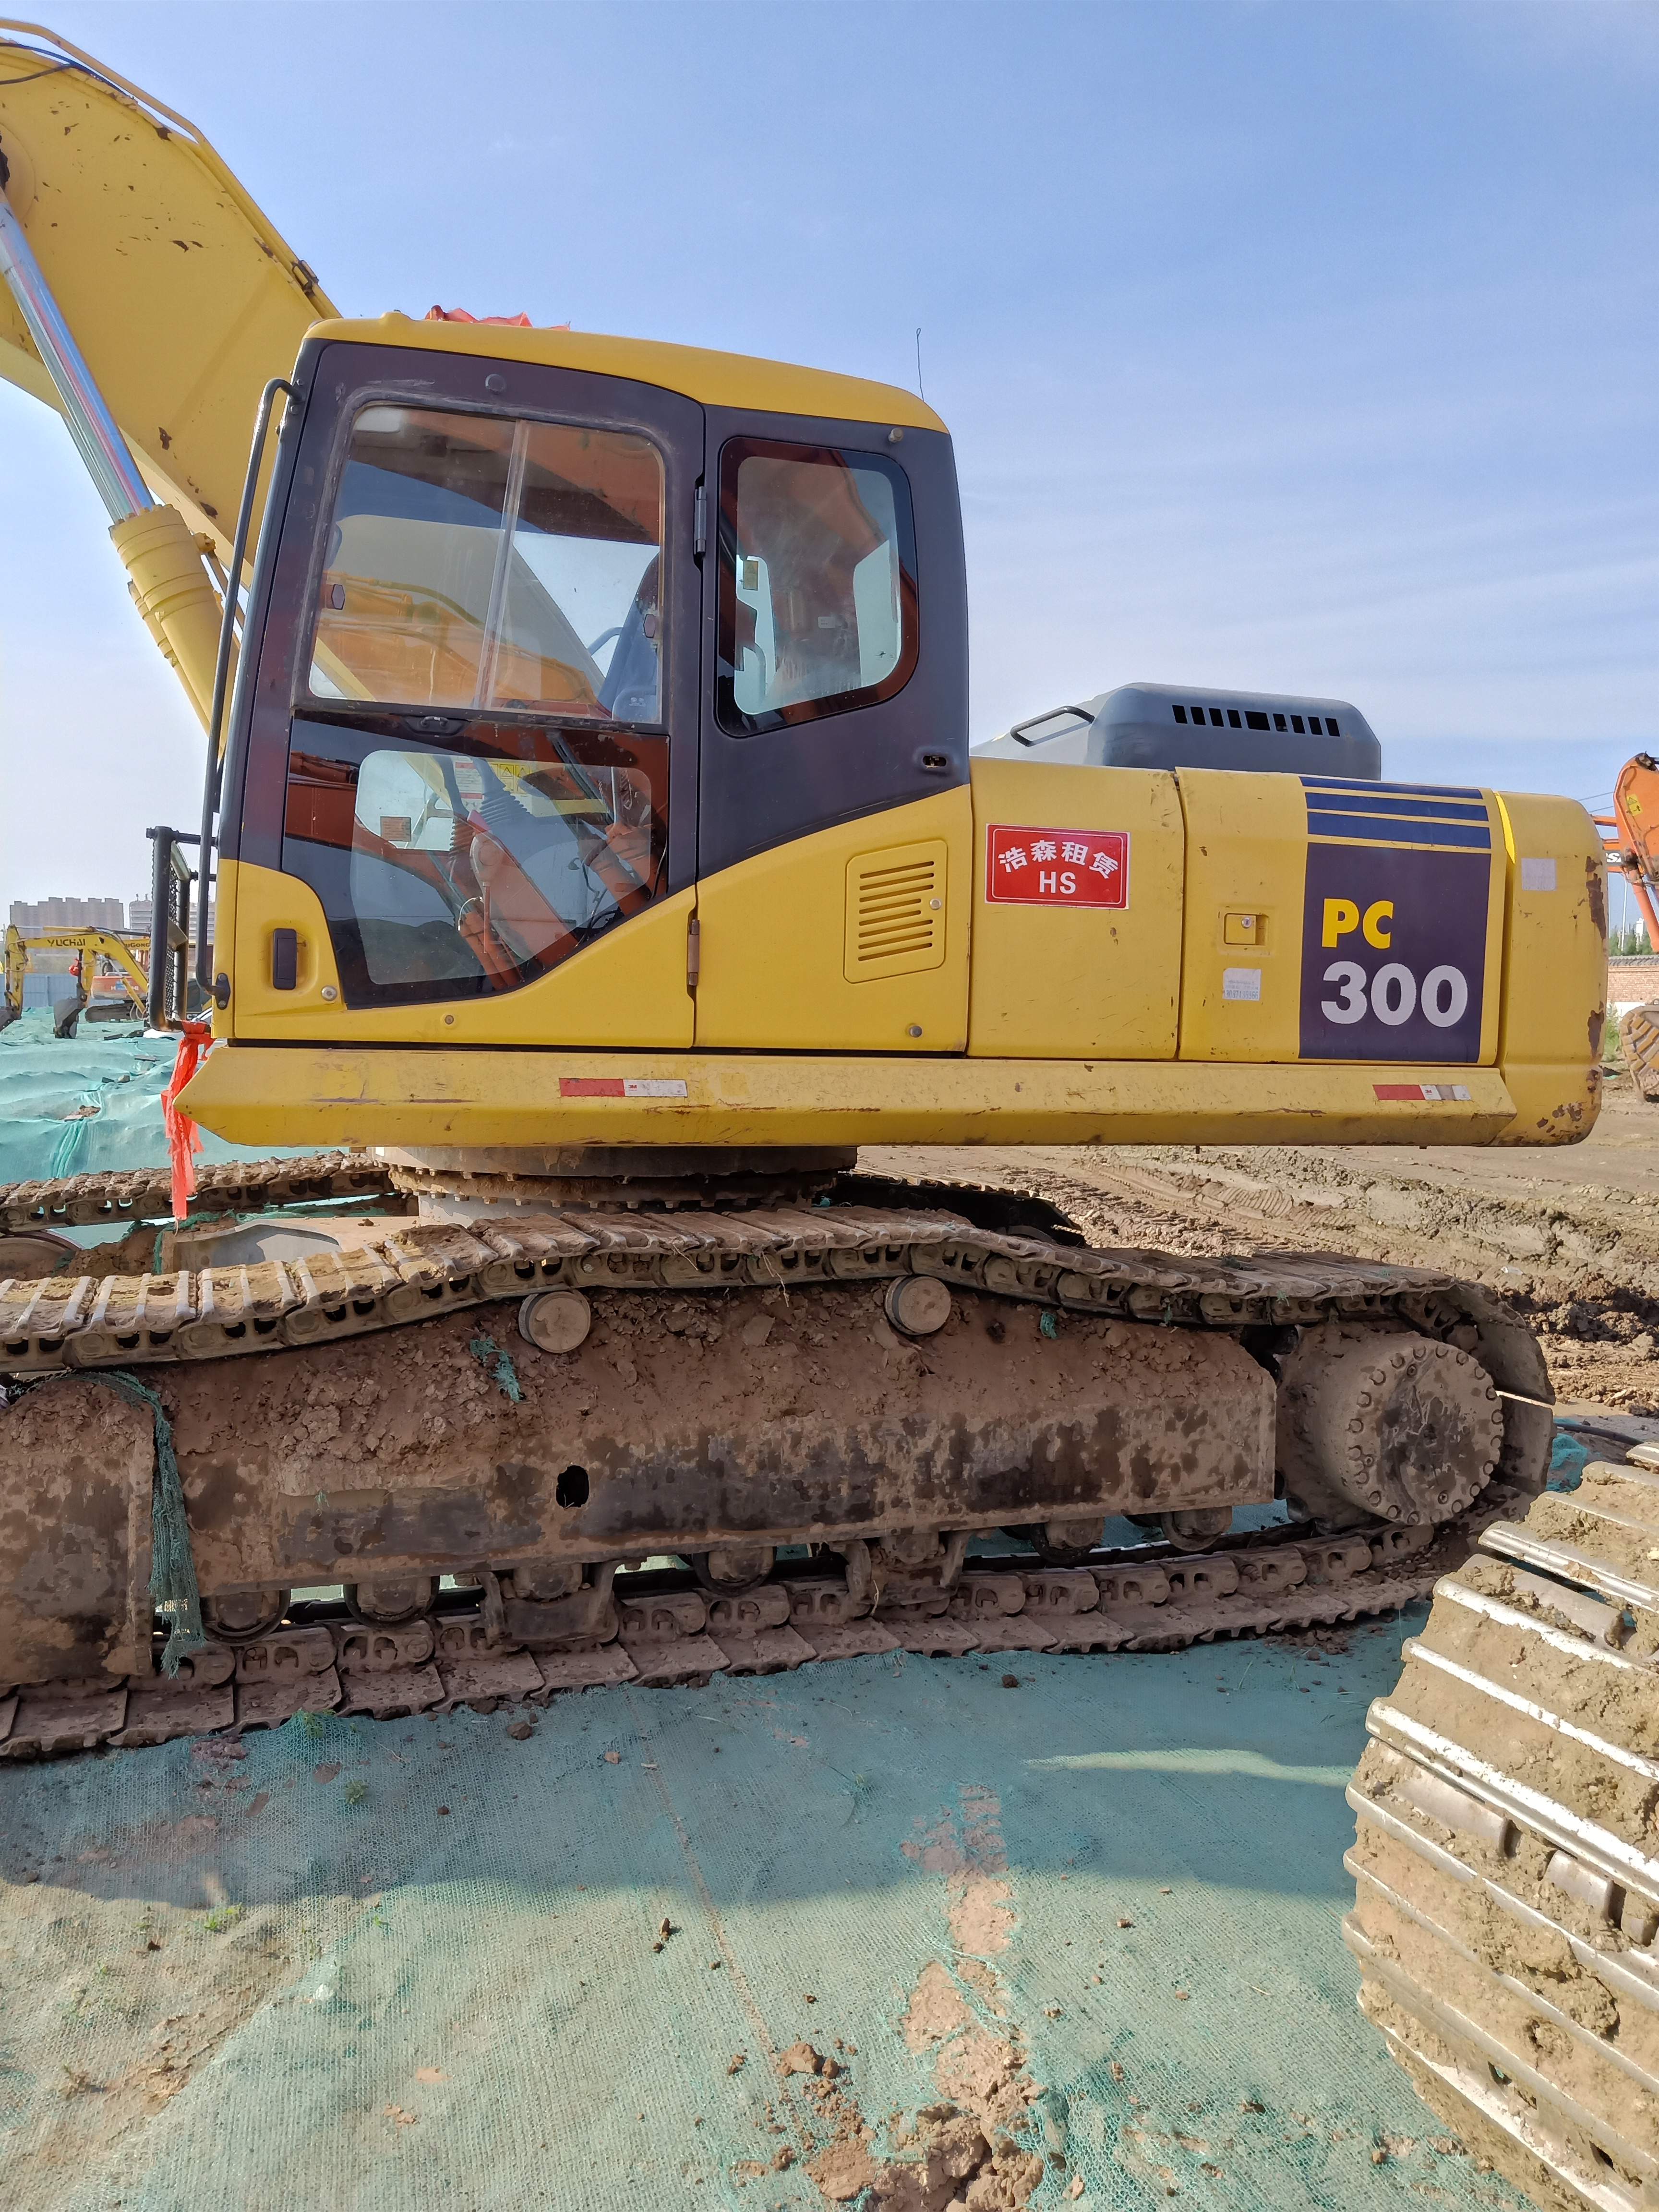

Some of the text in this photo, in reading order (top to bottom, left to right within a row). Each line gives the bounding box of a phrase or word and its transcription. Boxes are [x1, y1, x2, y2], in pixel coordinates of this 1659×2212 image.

[998, 840, 1118, 879] 浩森租赁
[1039, 870, 1076, 894] HS
[1322, 898, 1394, 949] PC
[1321, 961, 1468, 1027] 300
